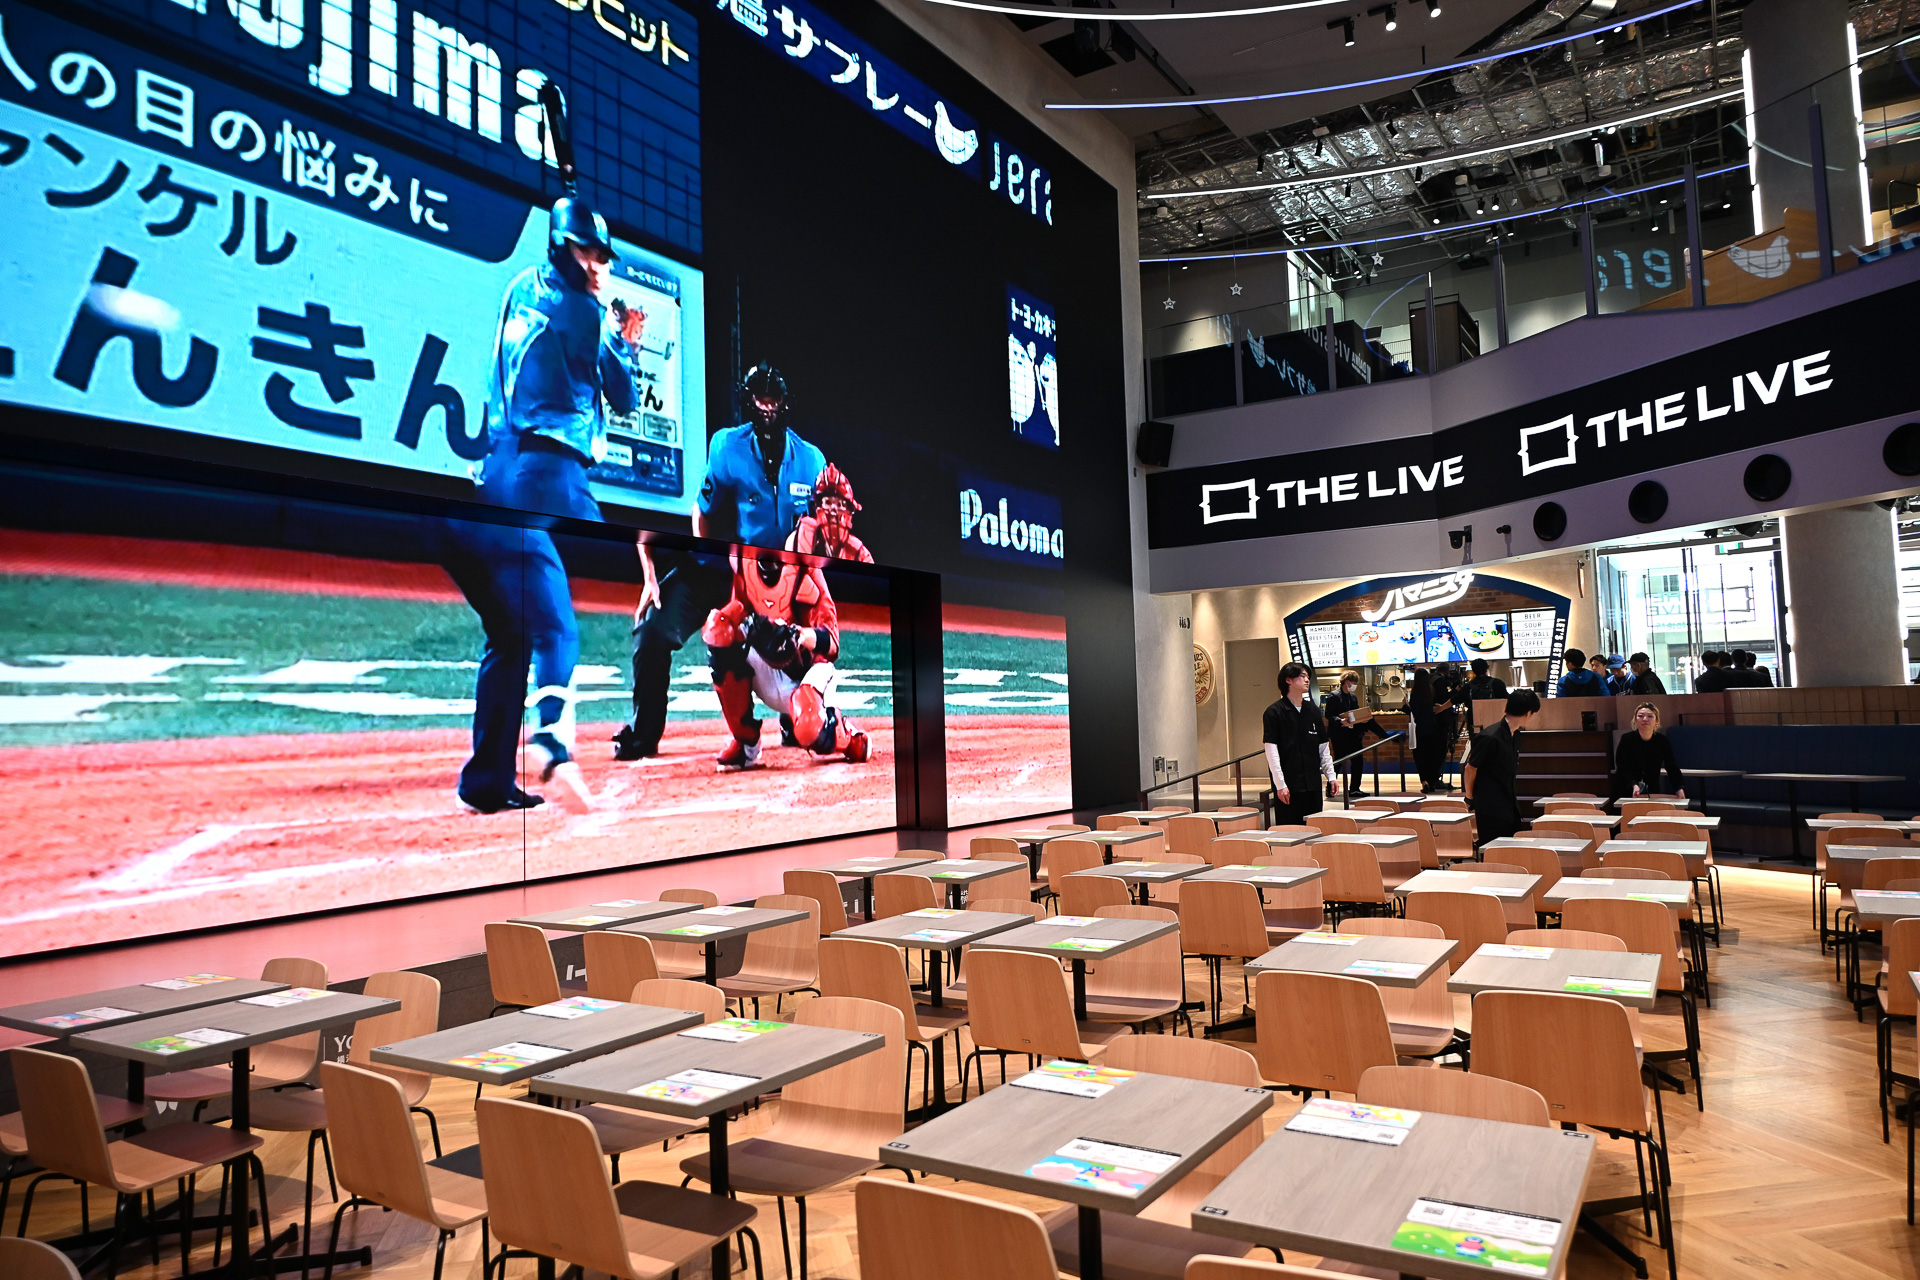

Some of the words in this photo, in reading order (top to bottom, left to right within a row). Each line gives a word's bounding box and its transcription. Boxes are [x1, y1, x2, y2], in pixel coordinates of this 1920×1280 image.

[555, 0, 690, 66] ヒット
[0, 246, 490, 462] んきん
[1586, 391, 1688, 449] THE
[1696, 350, 1834, 422] LIVE
[1266, 472, 1360, 509] THE
[1367, 454, 1465, 498] LIVE
[959, 488, 1065, 560] Paloma
[1552, 642, 1563, 658] GET
[1554, 618, 1566, 641] LET'S
